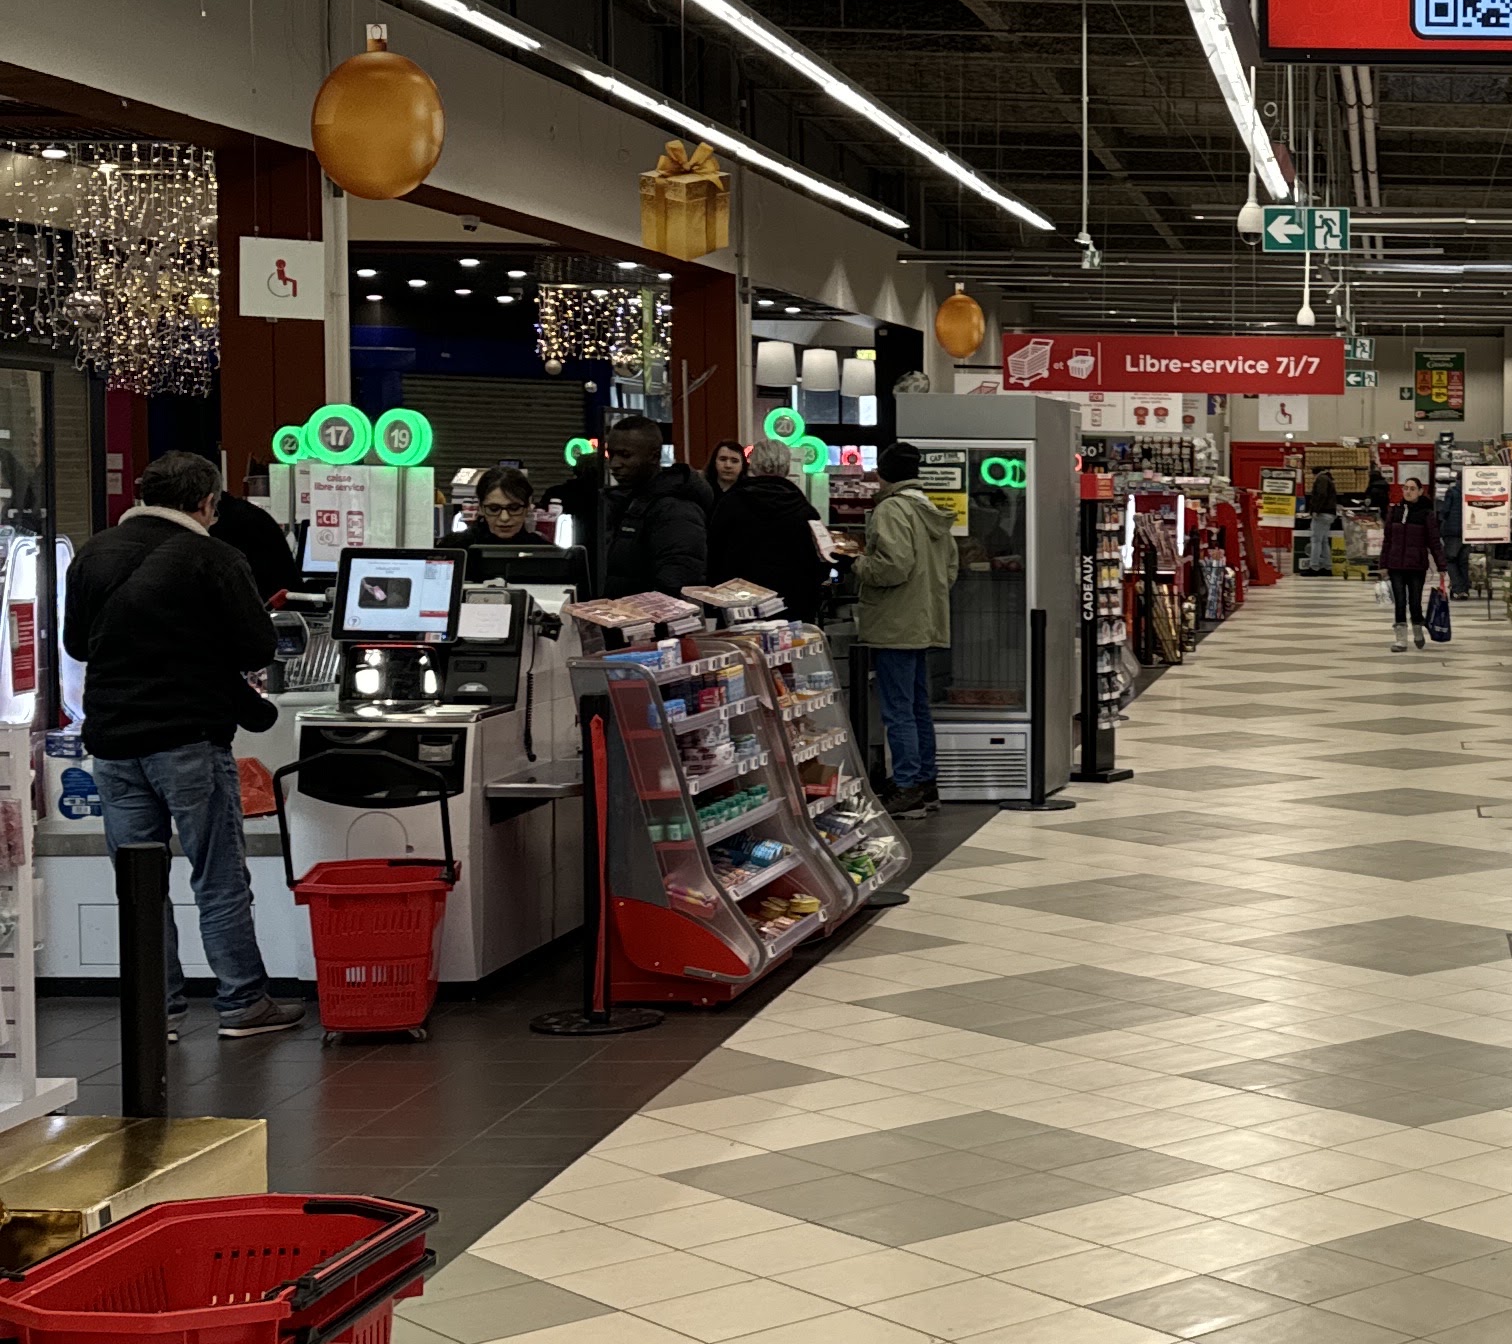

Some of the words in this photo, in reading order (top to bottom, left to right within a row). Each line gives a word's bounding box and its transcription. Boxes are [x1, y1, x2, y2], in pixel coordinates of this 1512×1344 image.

[1125, 354, 1269, 375] Libre-service
[1275, 355, 1321, 378] 7j/7
[325, 425, 350, 447] 17
[776, 420, 793, 433] 20
[390, 428, 410, 449] 19
[322, 512, 339, 525] CB
[1082, 555, 1094, 621] CADEAUX
